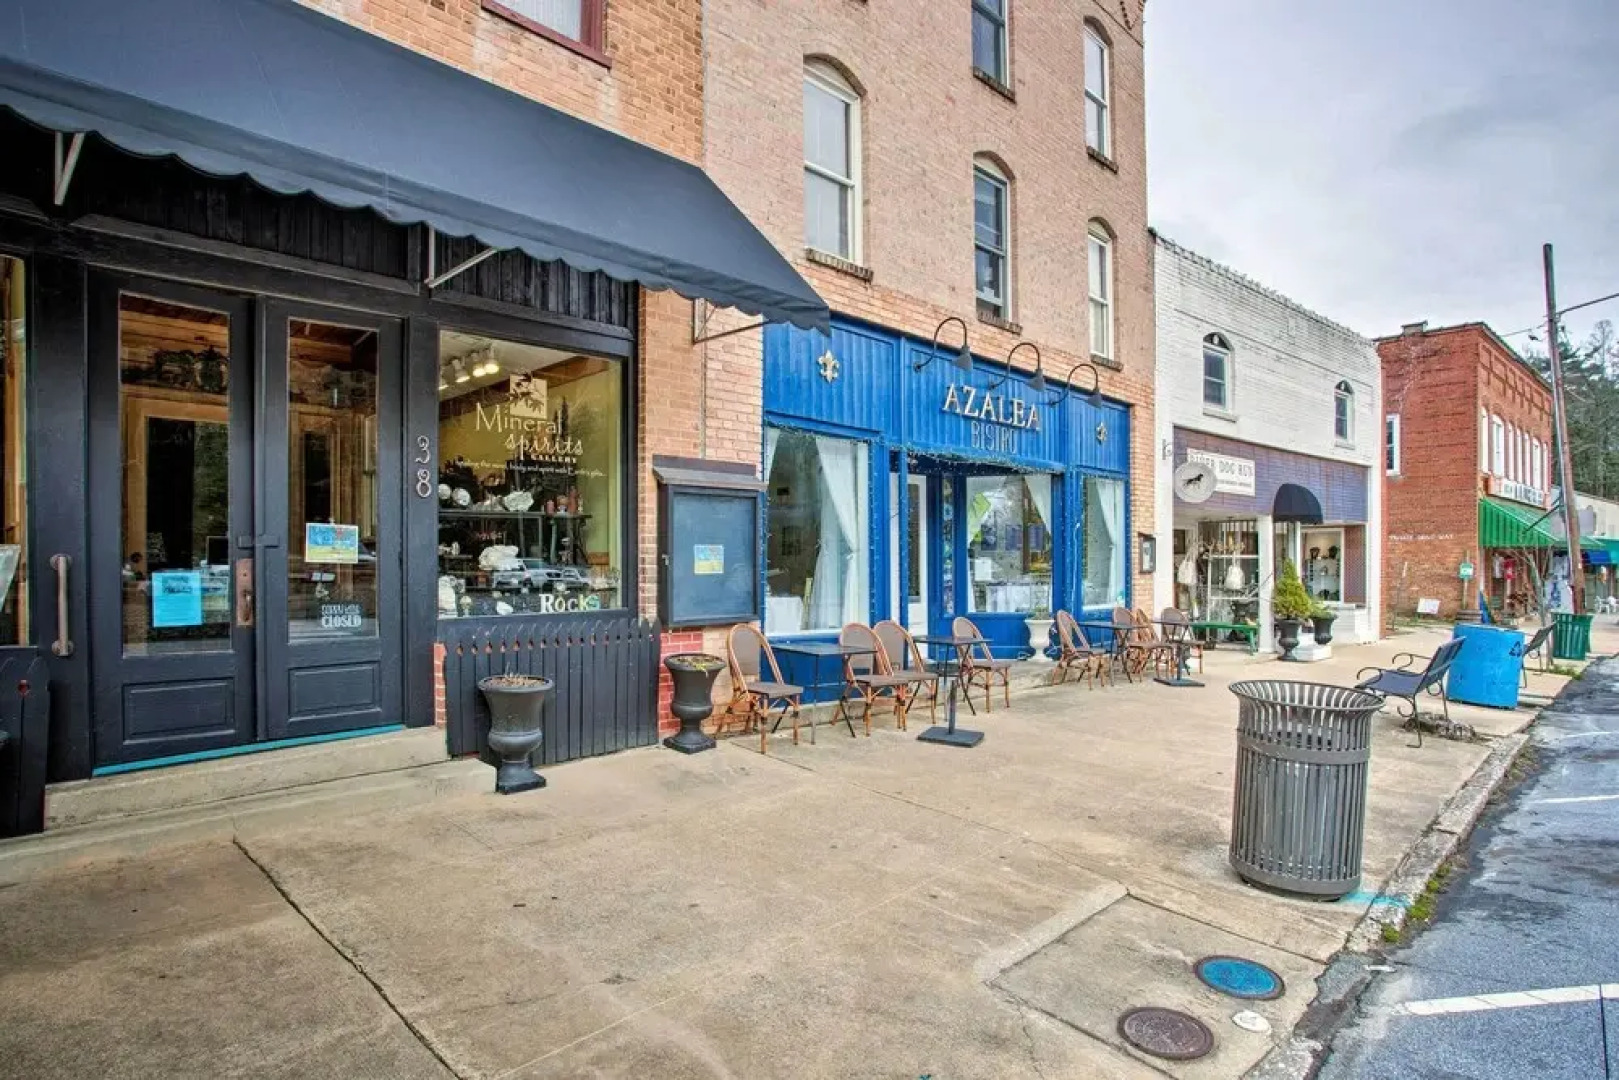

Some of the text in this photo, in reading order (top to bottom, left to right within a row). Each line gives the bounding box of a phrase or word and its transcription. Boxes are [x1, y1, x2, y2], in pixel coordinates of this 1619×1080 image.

[476, 402, 562, 435] Mineral
[942, 383, 1041, 432] AZALEA
[505, 433, 583, 460] spirits
[971, 420, 1018, 454] BISTRO
[415, 435, 431, 498] 38
[539, 593, 600, 614] Rocks
[321, 614, 362, 628] CLOSED
